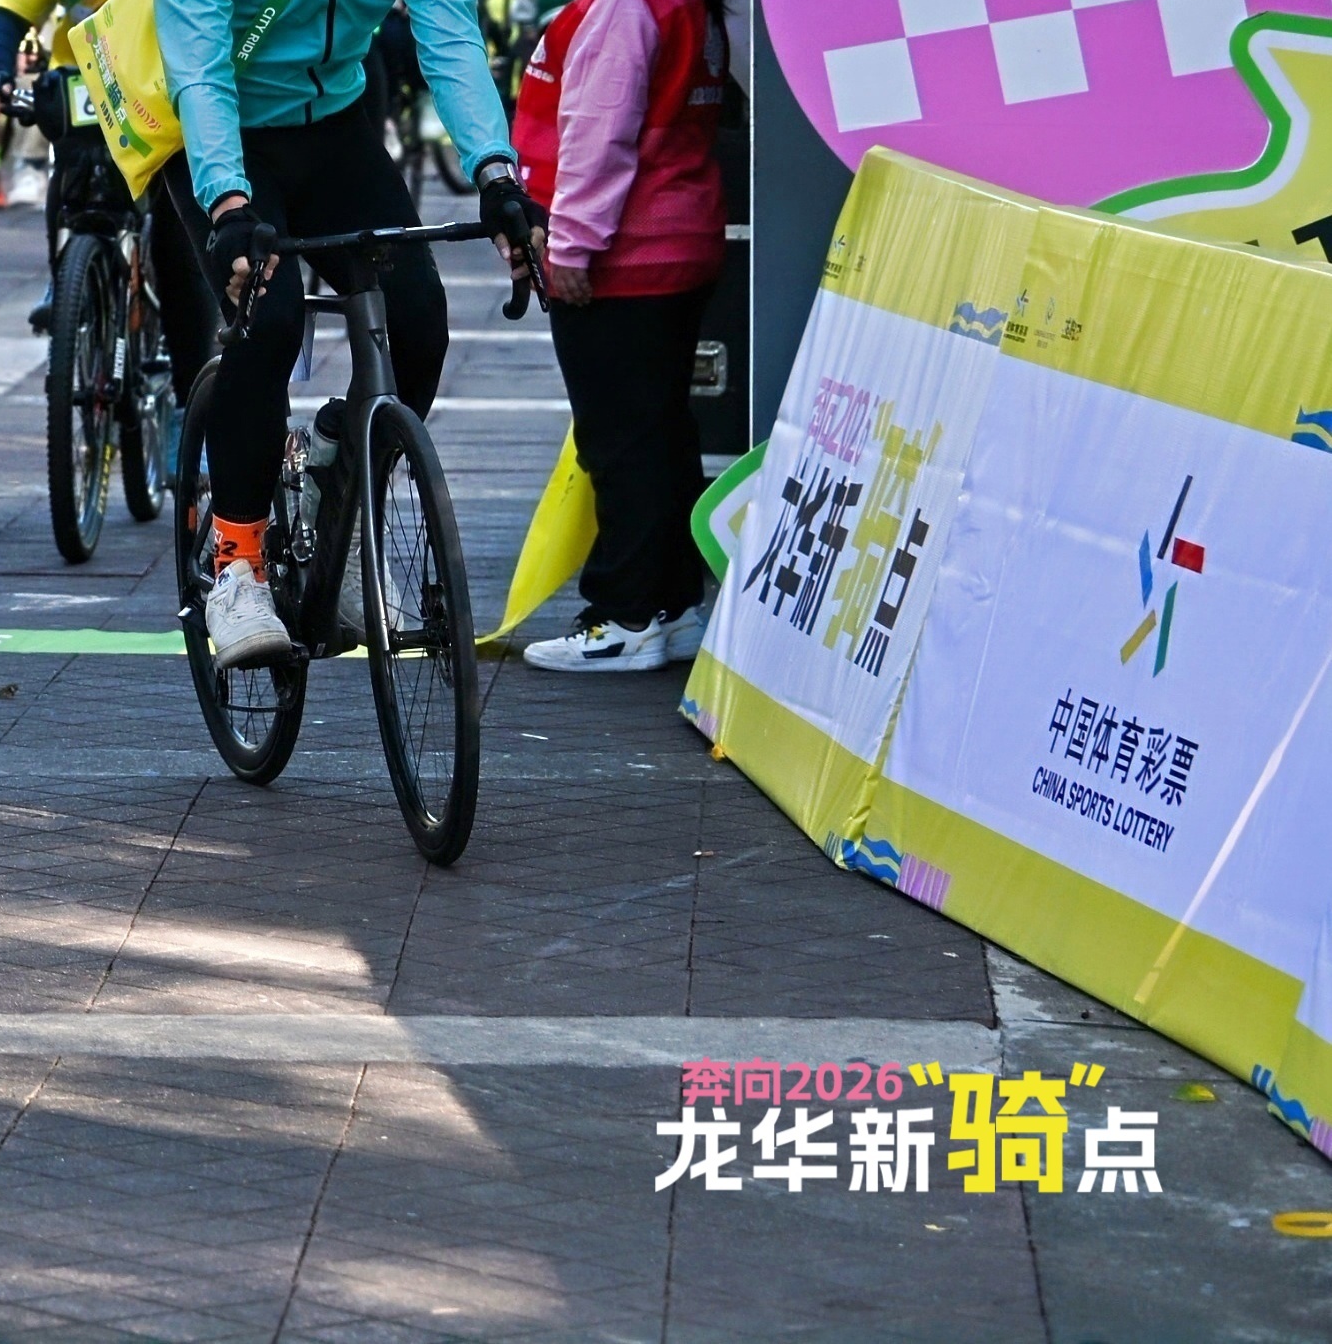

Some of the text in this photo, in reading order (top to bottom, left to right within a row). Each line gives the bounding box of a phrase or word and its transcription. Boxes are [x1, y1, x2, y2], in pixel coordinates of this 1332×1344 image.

[237, 6, 276, 62] CITY RIDE
[1048, 687, 1200, 807] 中国体育彩票
[1032, 765, 1175, 854] CHINA SPORTS LOTTERY
